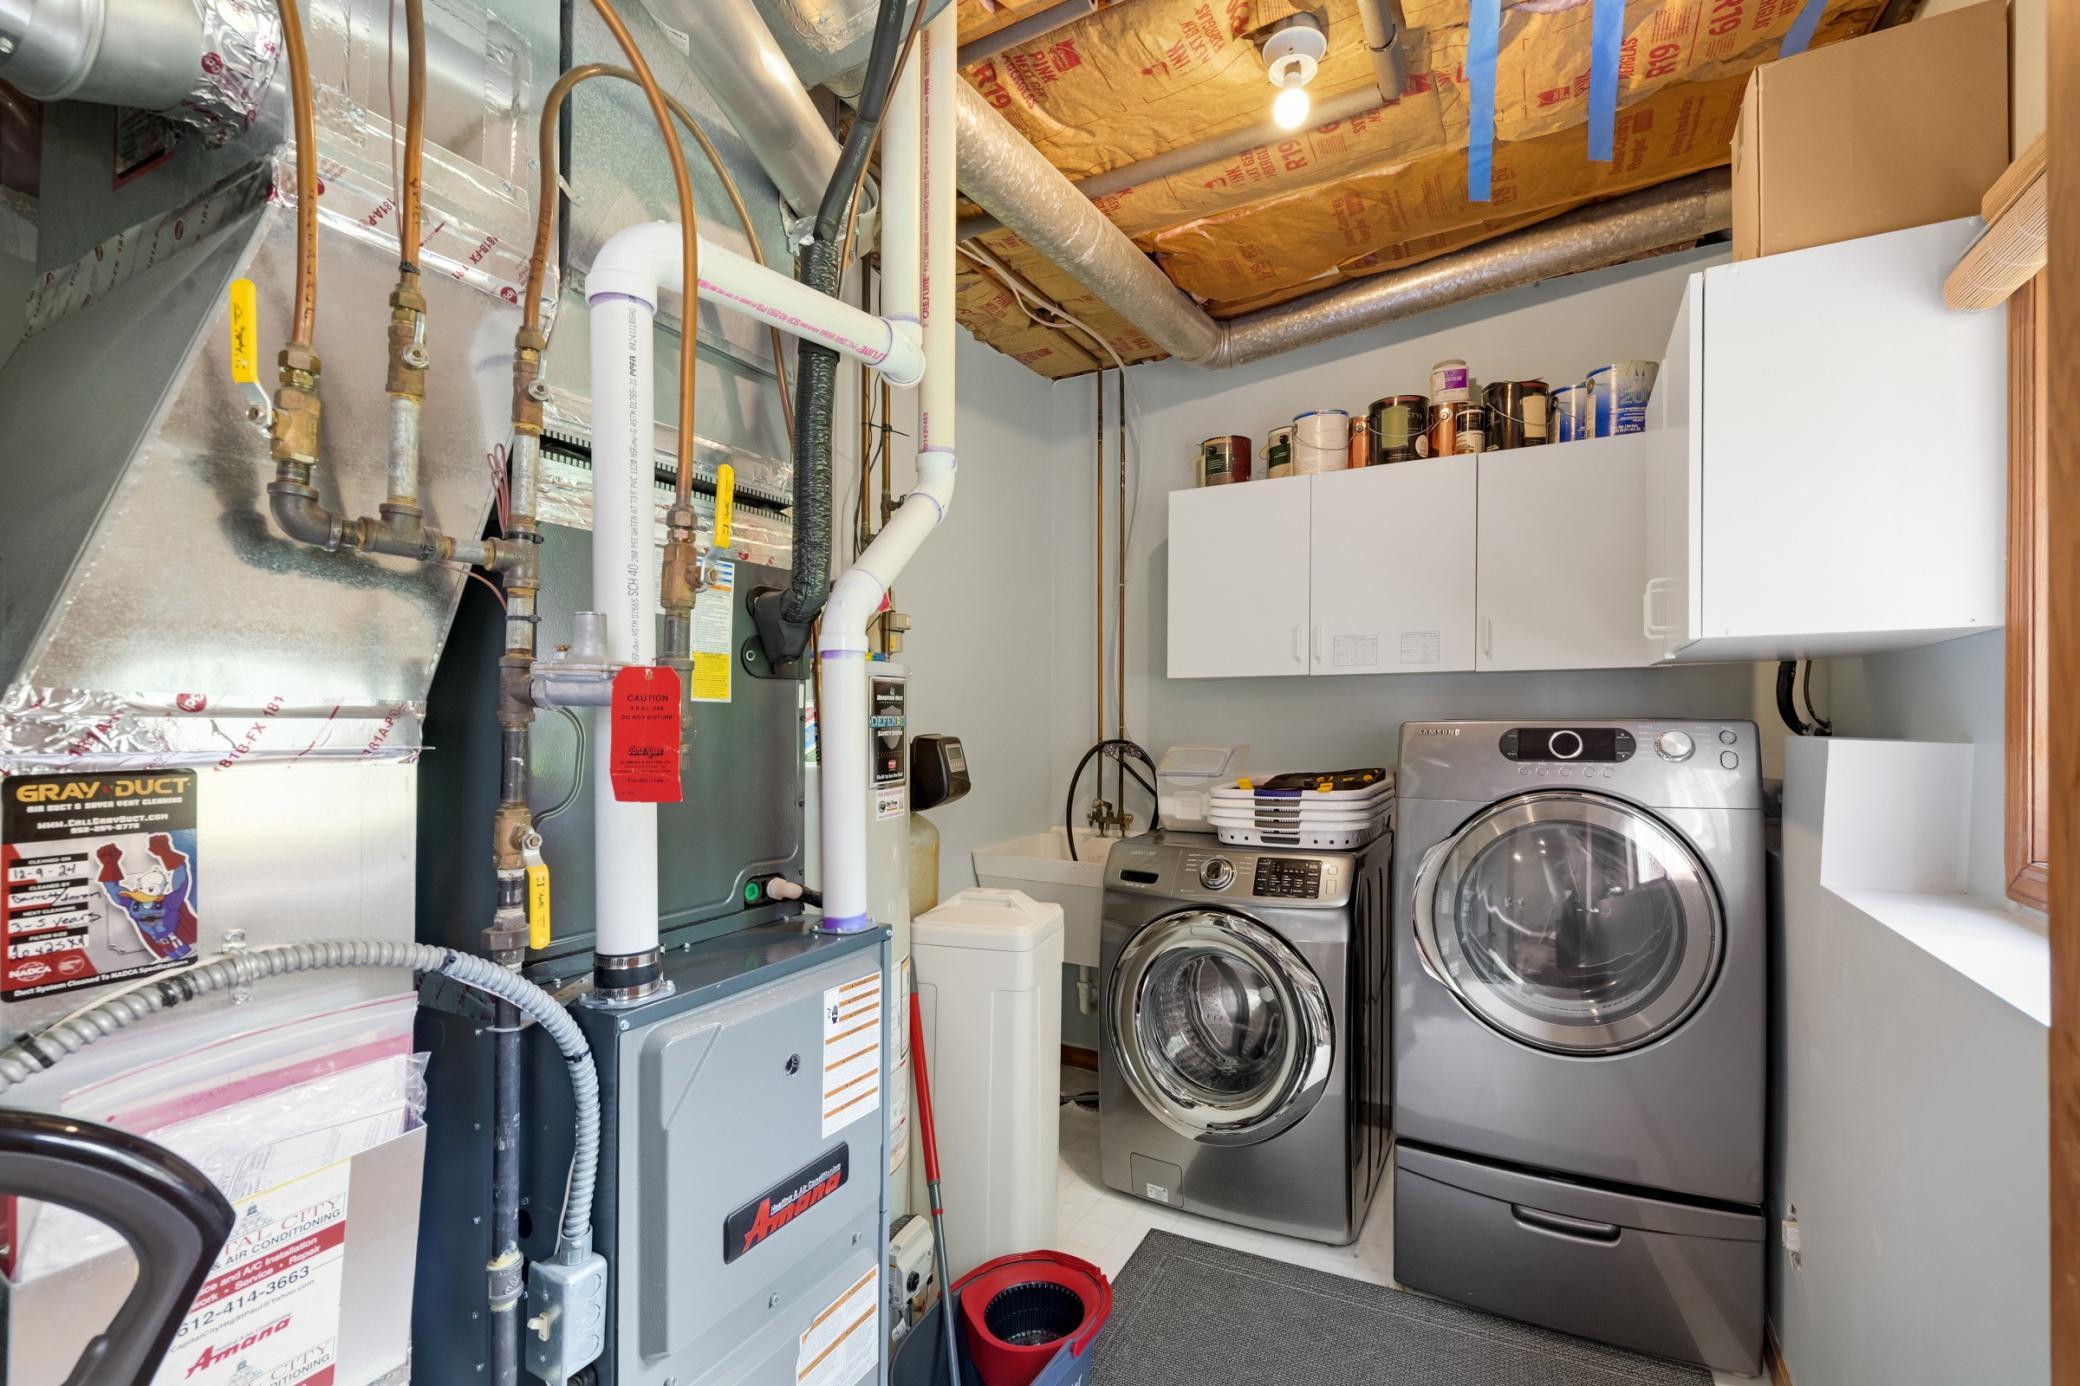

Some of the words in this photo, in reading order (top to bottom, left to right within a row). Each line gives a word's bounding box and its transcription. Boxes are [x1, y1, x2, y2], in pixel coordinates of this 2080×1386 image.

[1028, 50, 1060, 84] PINK
[1166, 38, 1192, 73] INK
[1646, 43, 1681, 80] R19
[971, 61, 1013, 110] R19
[1278, 138, 1309, 173] R19
[1225, 165, 1245, 184] INK
[630, 476, 638, 489] PVC
[630, 515, 638, 536] WATER
[627, 565, 639, 577] 40
[627, 577, 639, 597] SCH
[1417, 727, 1461, 736] SAMSUNG
[16, 781, 100, 803] GRAY
[114, 777, 190, 797] DUCT
[47, 803, 72, 812] DUCT
[8, 966, 52, 979] NADCA
[14, 986, 34, 998] Duct
[36, 982, 67, 994] System
[67, 976, 101, 988] Cleaned
[111, 968, 139, 980] NADCA
[281, 1200, 338, 1230] CITY
[742, 1170, 842, 1254] Amana
[225, 1250, 248, 1266] AIR
[252, 1209, 341, 1255] CONDITIONING
[220, 1271, 241, 1289] and
[242, 1260, 264, 1276] A/C
[265, 1237, 318, 1267] Installation
[235, 1267, 274, 1291] Service
[289, 1245, 321, 1265] Repair
[185, 1317, 294, 1380] Amana
[271, 1346, 330, 1380] CITY
[270, 1354, 330, 1386] DITIONING
